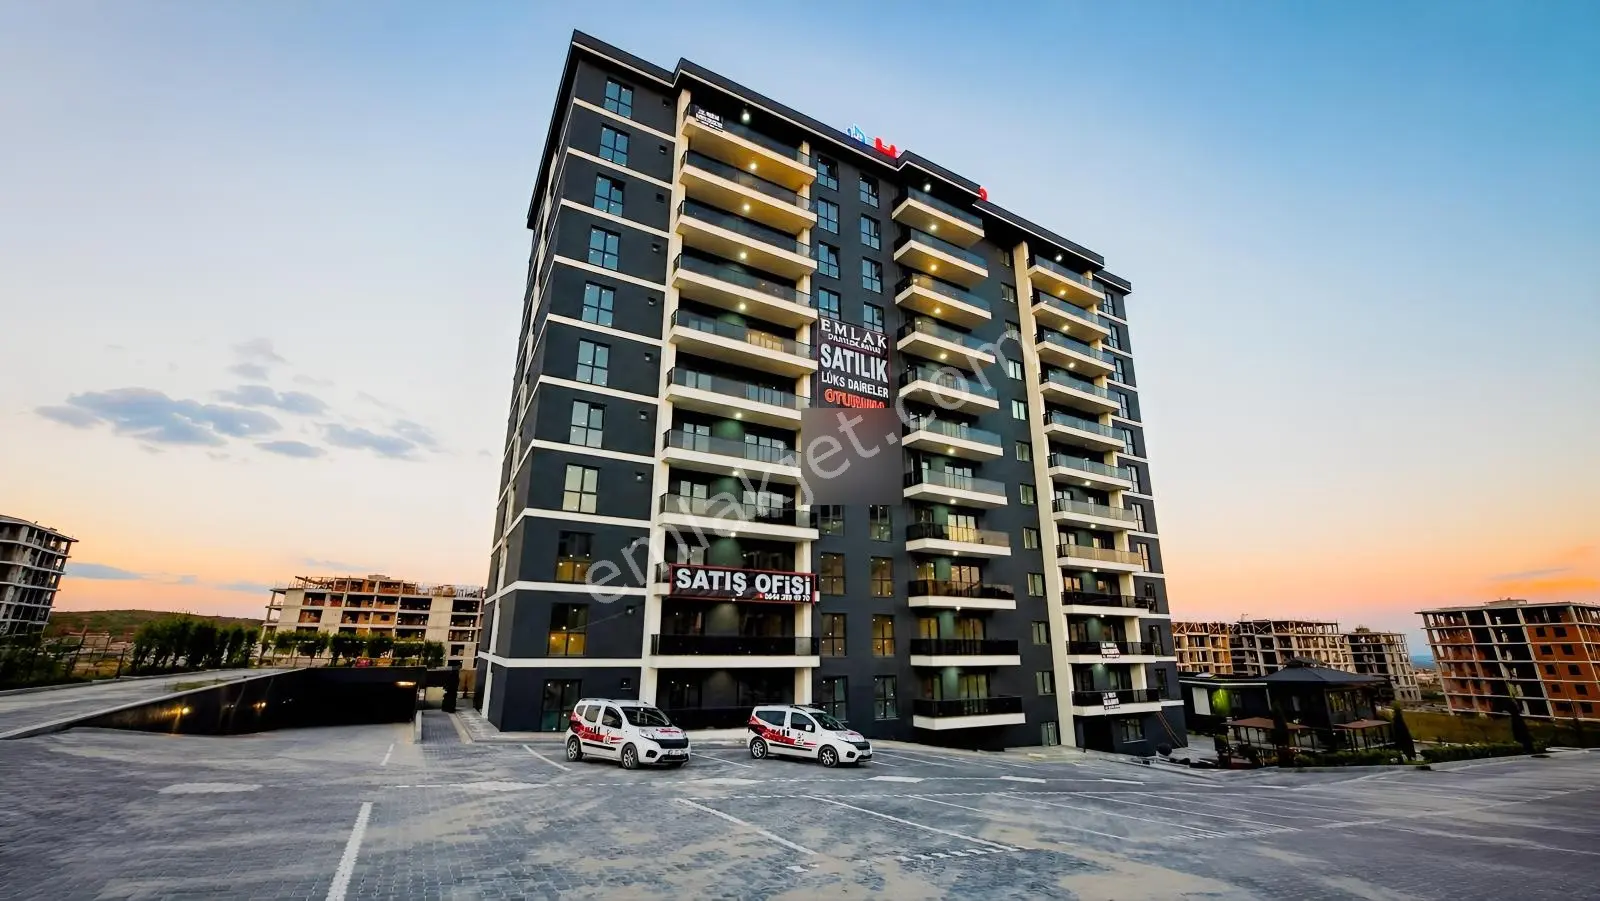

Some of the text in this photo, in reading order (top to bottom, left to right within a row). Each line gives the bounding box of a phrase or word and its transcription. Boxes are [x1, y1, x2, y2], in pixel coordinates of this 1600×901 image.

[820, 318, 887, 349] EMLAK
[820, 343, 889, 384] SATILIK
[821, 370, 846, 387] LÜKS
[676, 568, 811, 597] SATIŞ OFİSİ
